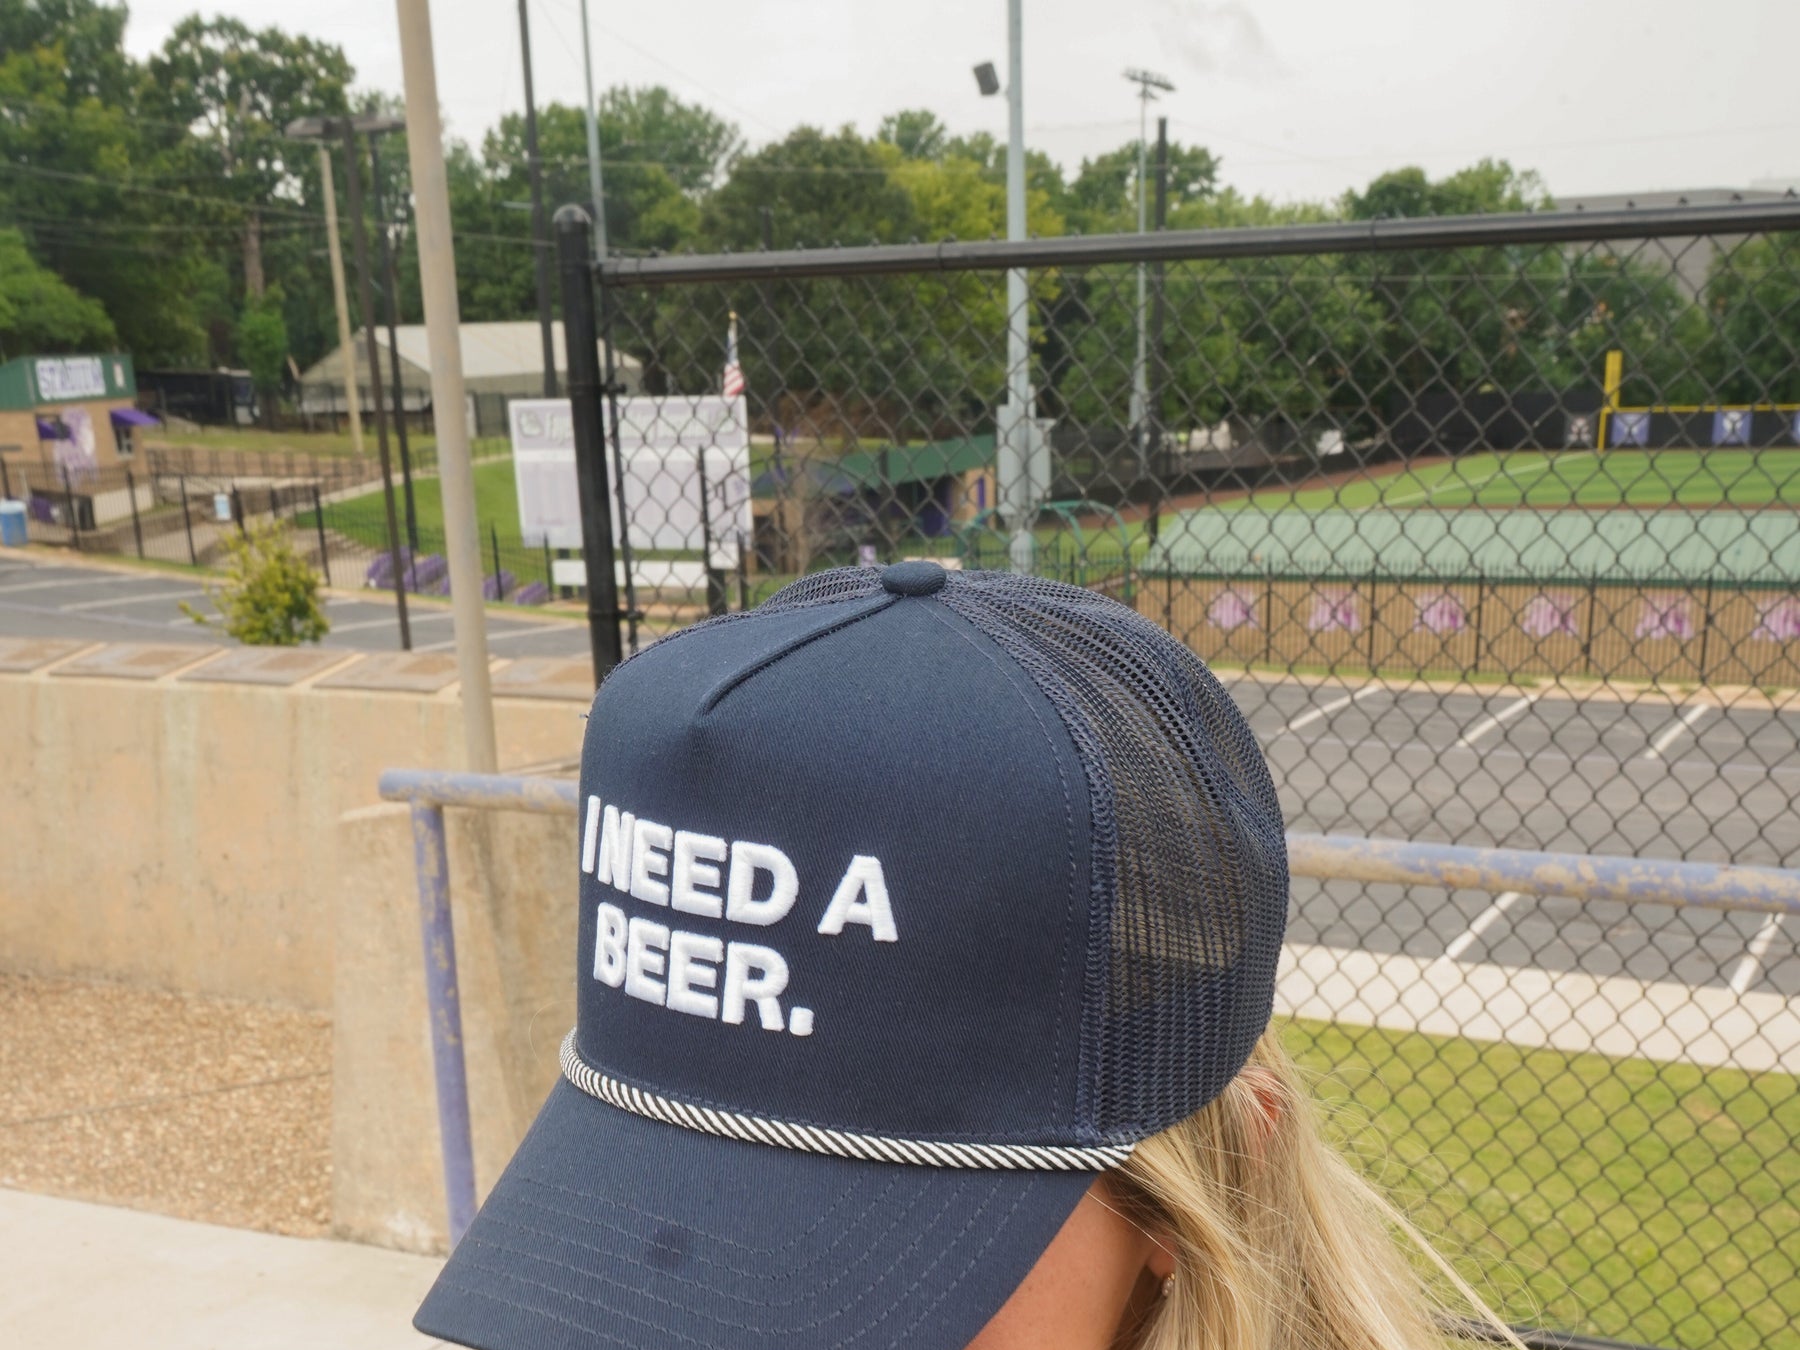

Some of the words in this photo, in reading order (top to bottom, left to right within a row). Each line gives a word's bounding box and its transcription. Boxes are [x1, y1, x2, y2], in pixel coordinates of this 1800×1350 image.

[582, 795, 600, 874] I
[598, 804, 799, 927] NEED
[817, 854, 899, 942] A
[593, 902, 814, 1036] BEER.
